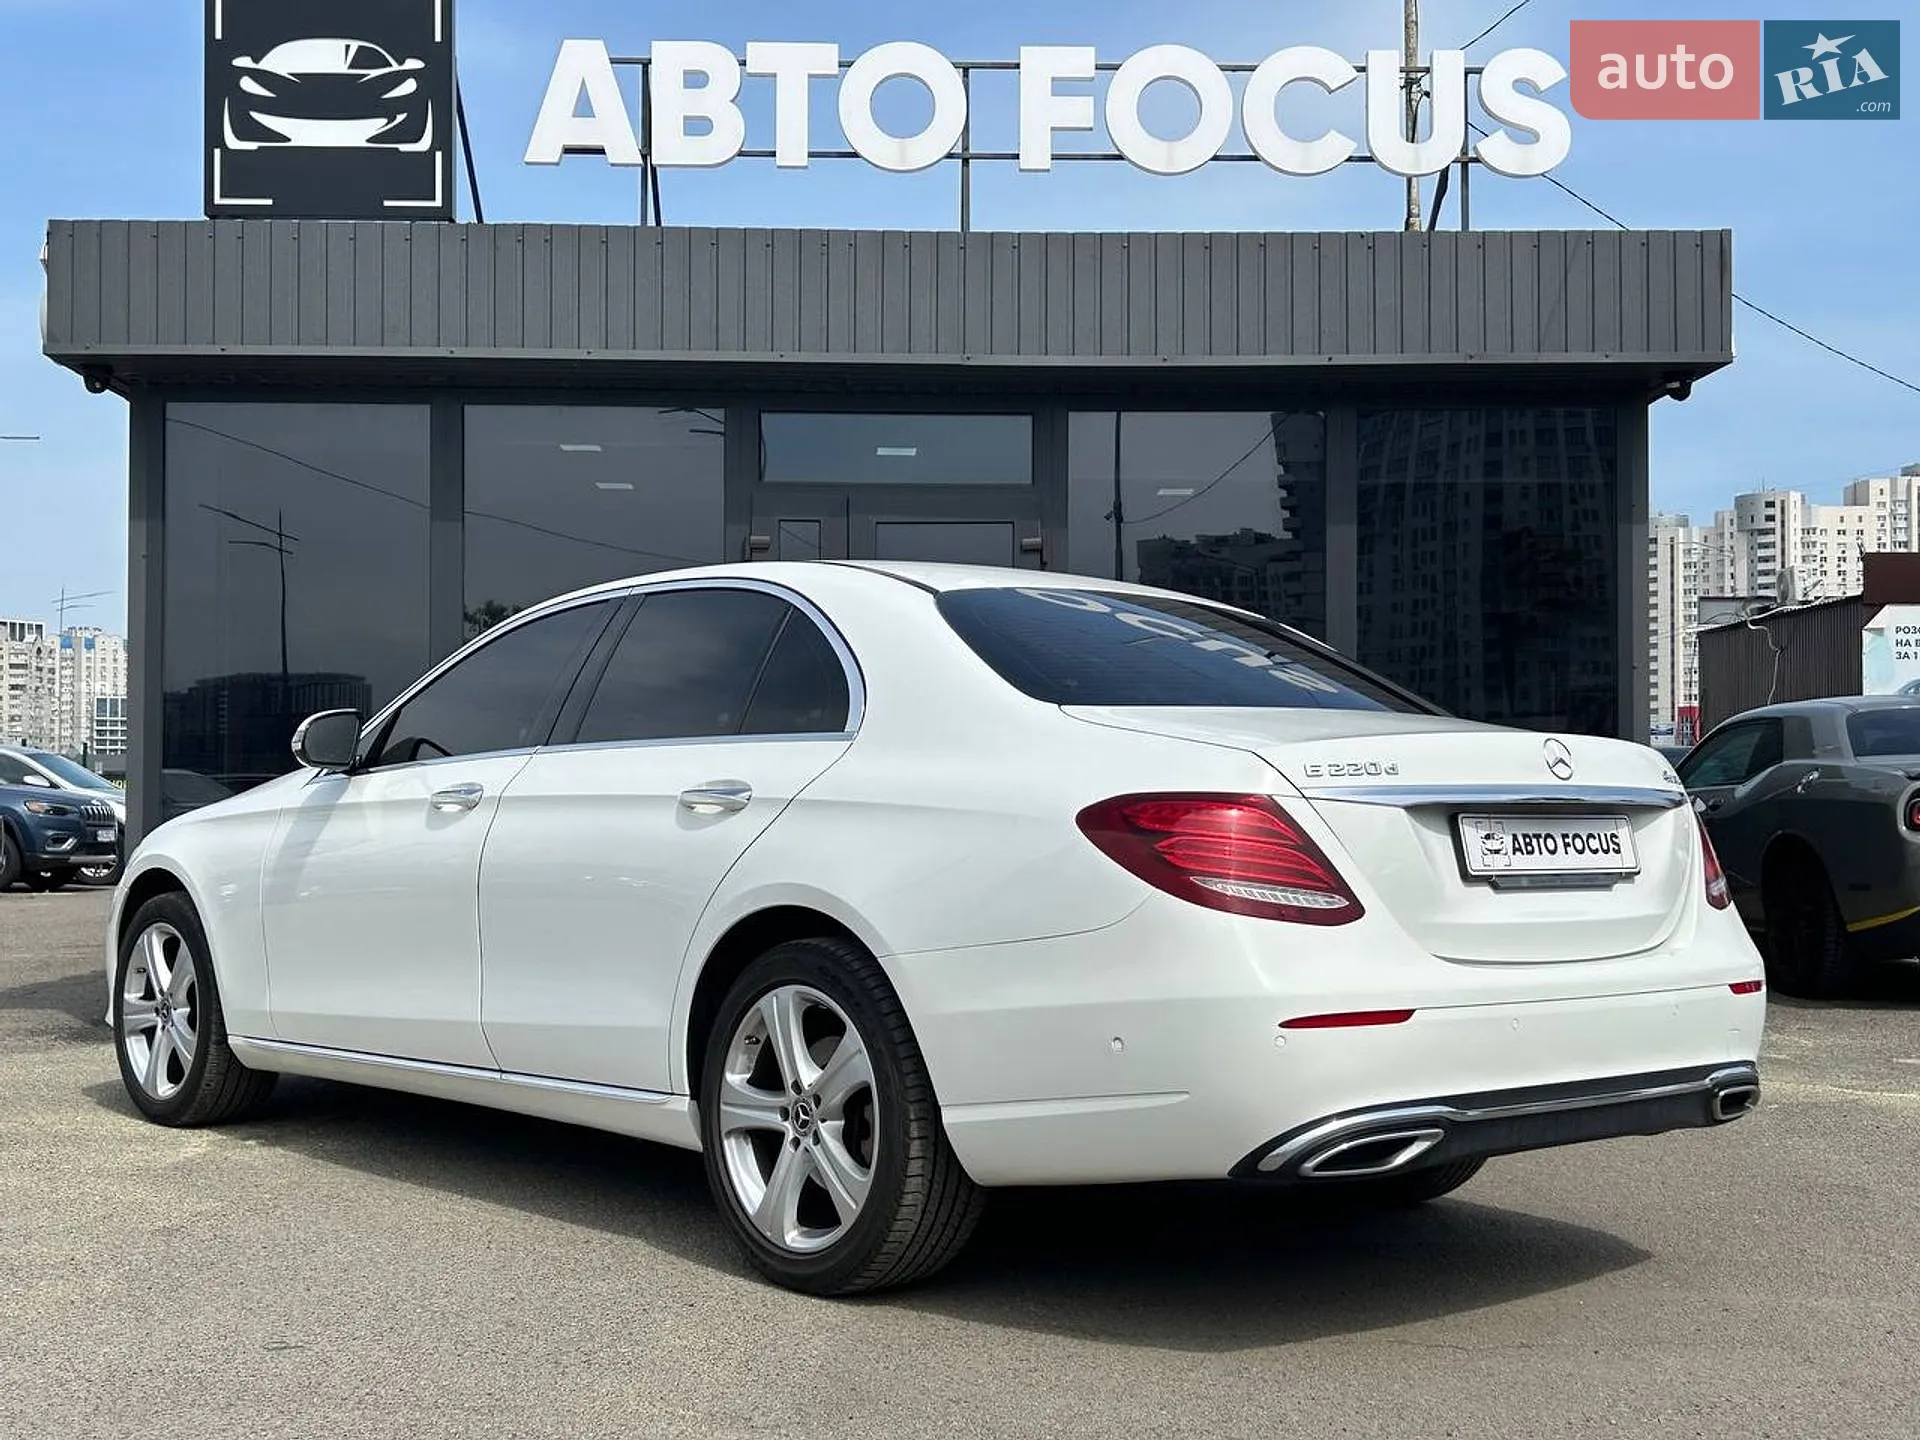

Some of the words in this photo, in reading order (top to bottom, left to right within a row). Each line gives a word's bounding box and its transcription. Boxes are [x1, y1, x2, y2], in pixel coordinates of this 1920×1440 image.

[524, 39, 968, 172] АВТО
[1018, 44, 1572, 176] FOCUS
[1895, 639, 1912, 648] НА
[1895, 651, 1911, 660] ЗА
[1304, 763, 1324, 778] E
[1327, 761, 1400, 777] 220d
[1562, 832, 1622, 856] FOCUS
